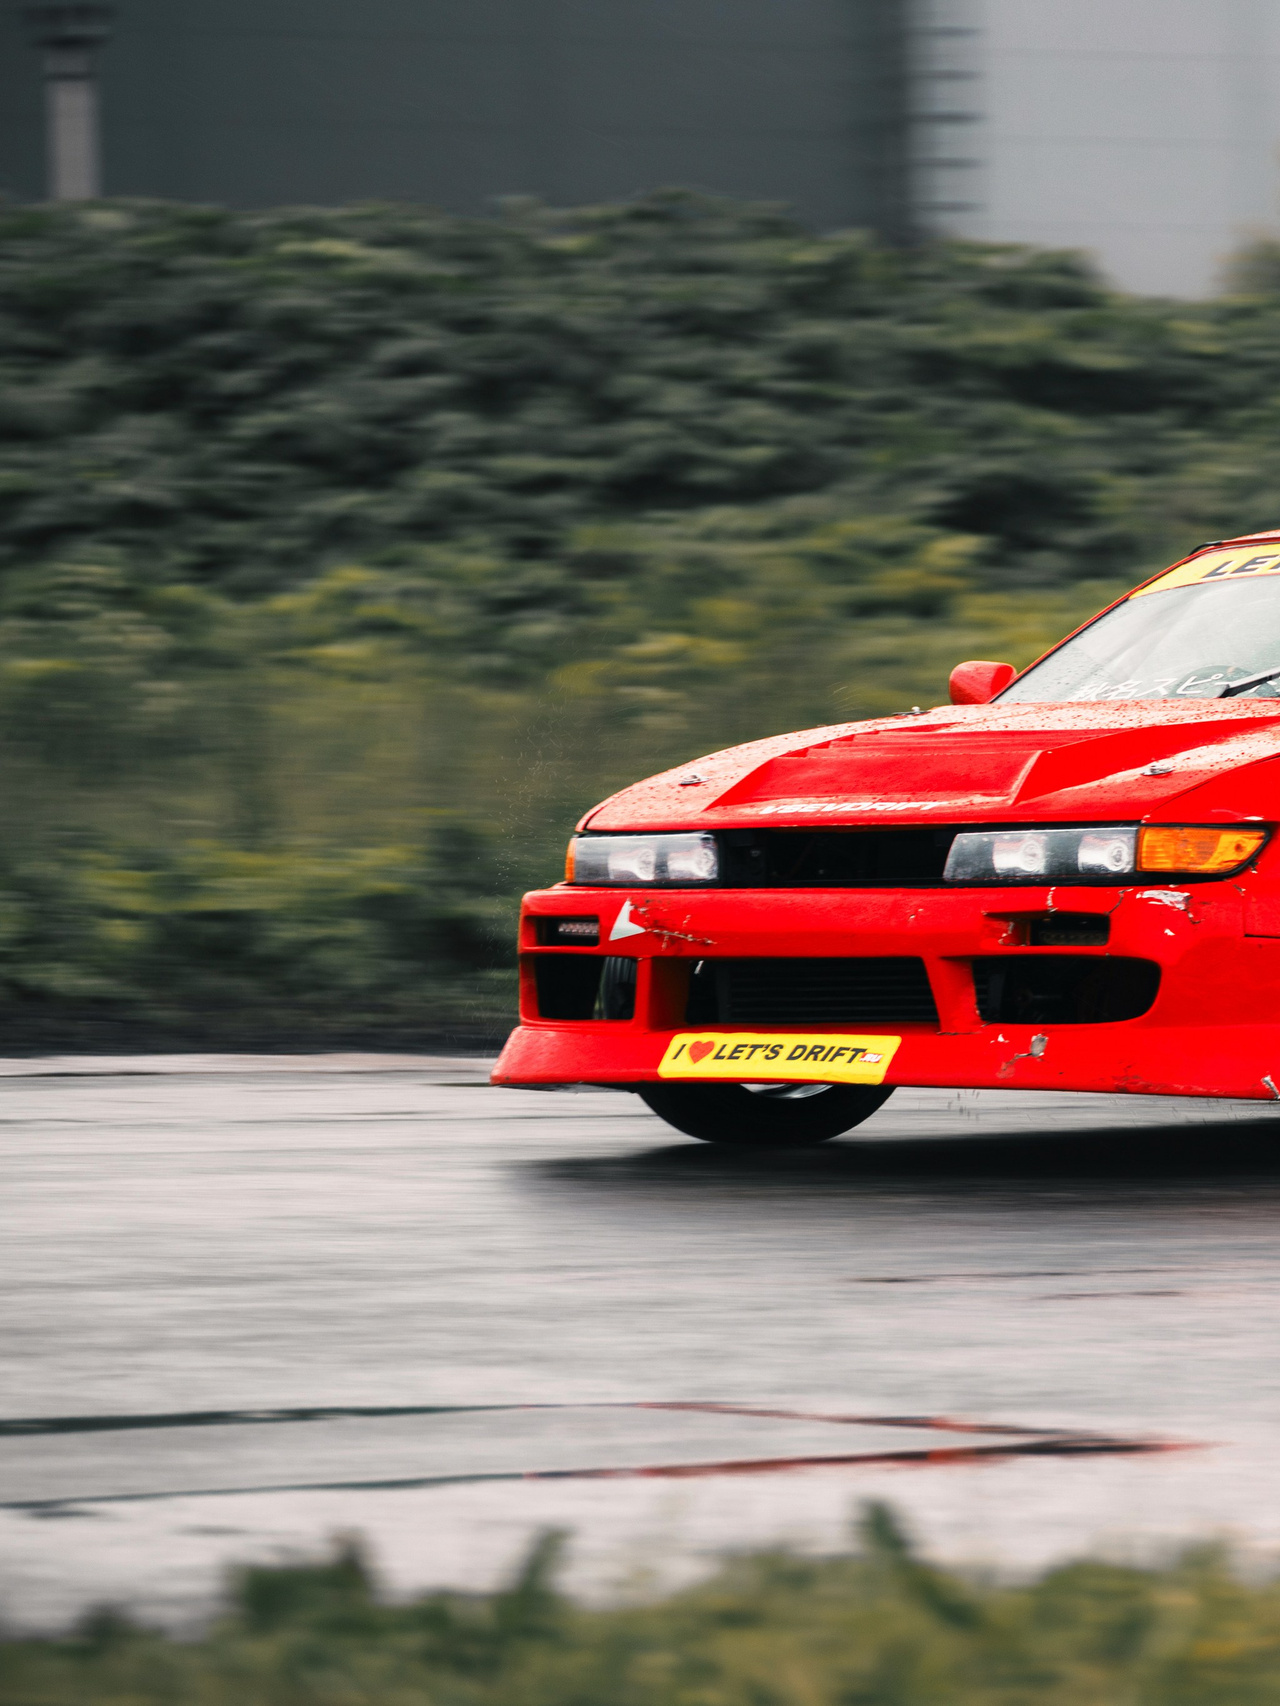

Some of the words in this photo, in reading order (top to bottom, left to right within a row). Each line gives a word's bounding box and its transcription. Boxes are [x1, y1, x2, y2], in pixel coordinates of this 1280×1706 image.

[759, 802, 948, 814] VSEVDRIFT
[712, 1044, 784, 1061] LET'S
[785, 1045, 868, 1064] DRIFT
